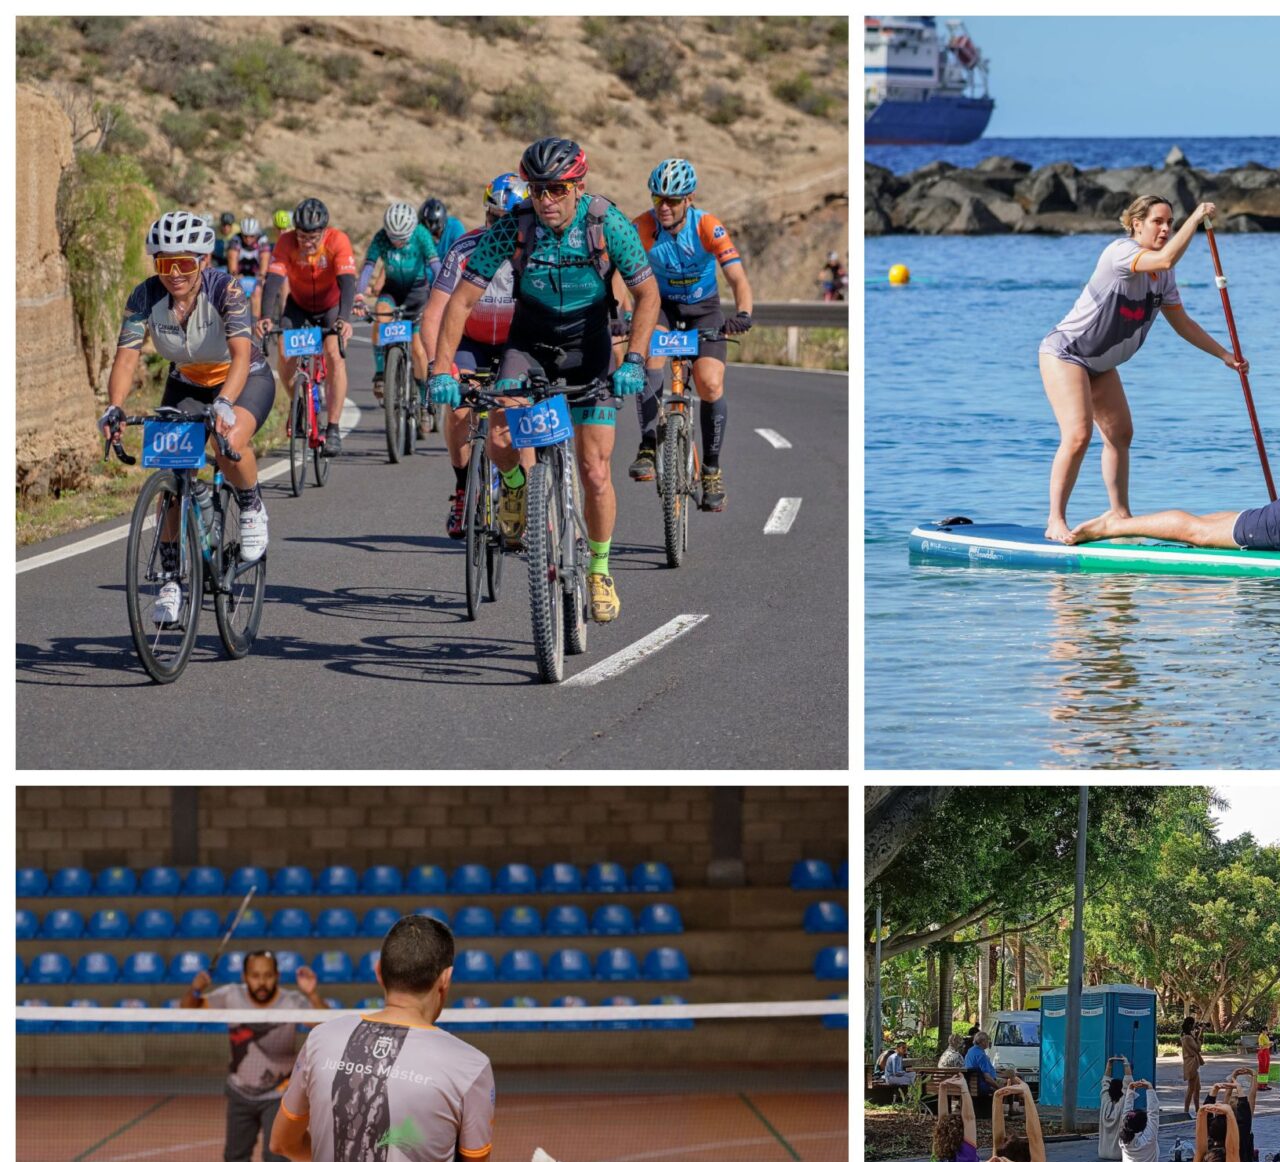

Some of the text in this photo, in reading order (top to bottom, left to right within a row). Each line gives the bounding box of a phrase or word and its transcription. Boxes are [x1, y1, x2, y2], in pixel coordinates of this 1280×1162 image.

[384, 325, 406, 337] 032
[290, 334, 316, 348] 014
[658, 334, 688, 346] 041
[519, 409, 560, 434] 033
[153, 432, 193, 453] 004
[322, 1058, 434, 1086] Juegos Máster
